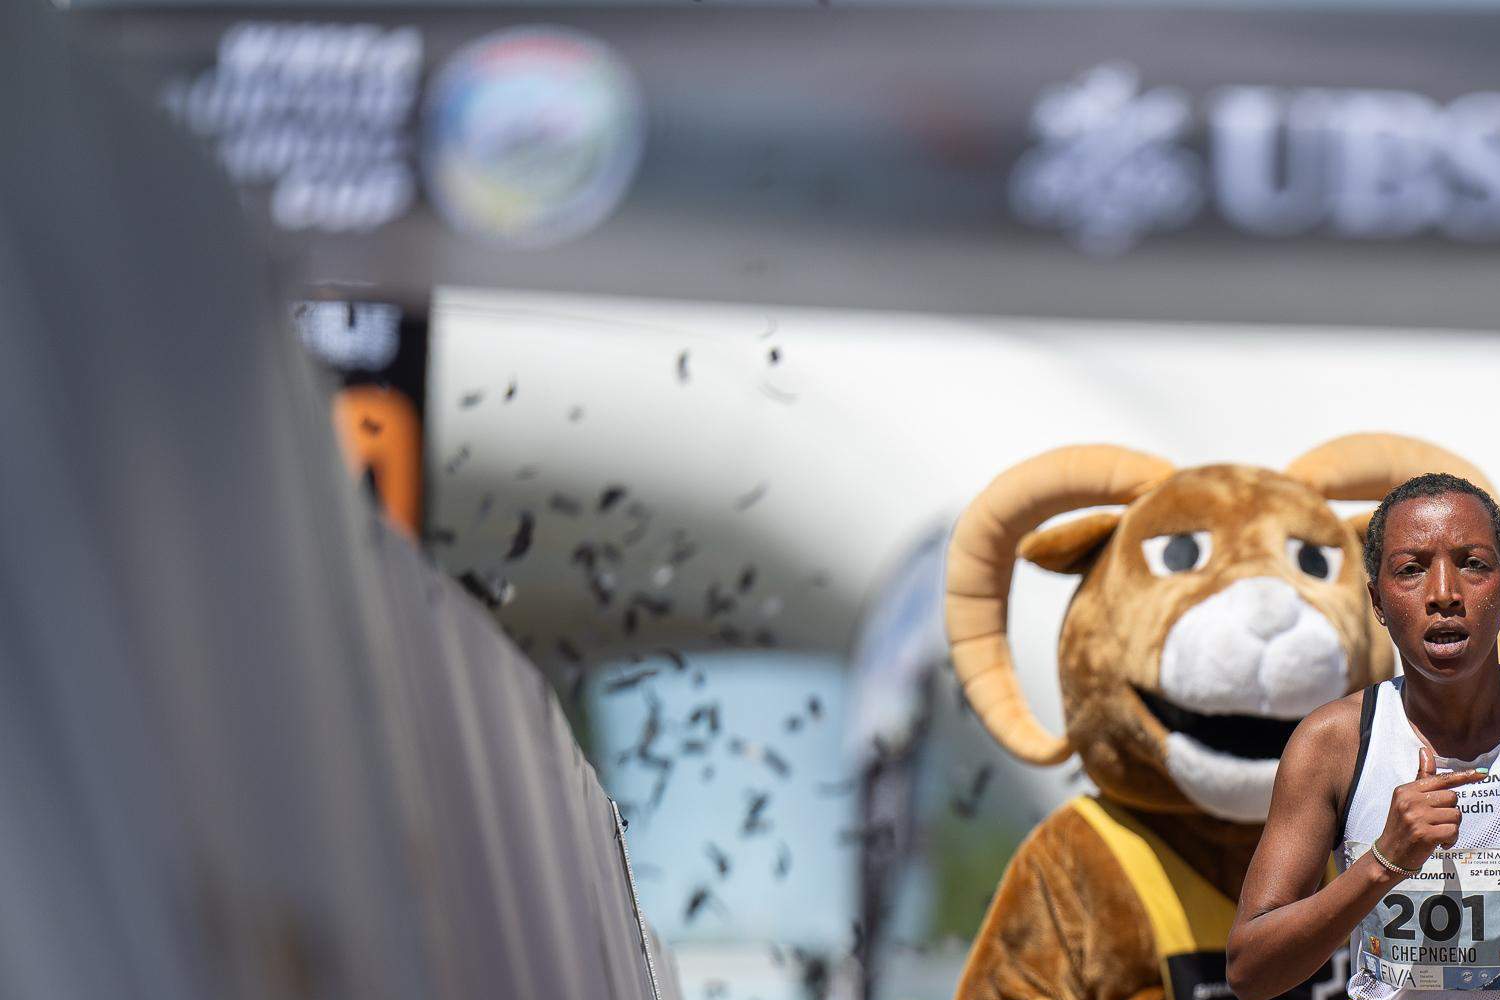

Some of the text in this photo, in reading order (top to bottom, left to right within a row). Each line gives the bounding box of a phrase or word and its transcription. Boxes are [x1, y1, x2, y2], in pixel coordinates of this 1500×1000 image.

[1407, 872, 1456, 880] ALOMON
[1382, 893, 1485, 942] 201
[1391, 945, 1477, 963] CHEPNGENO
